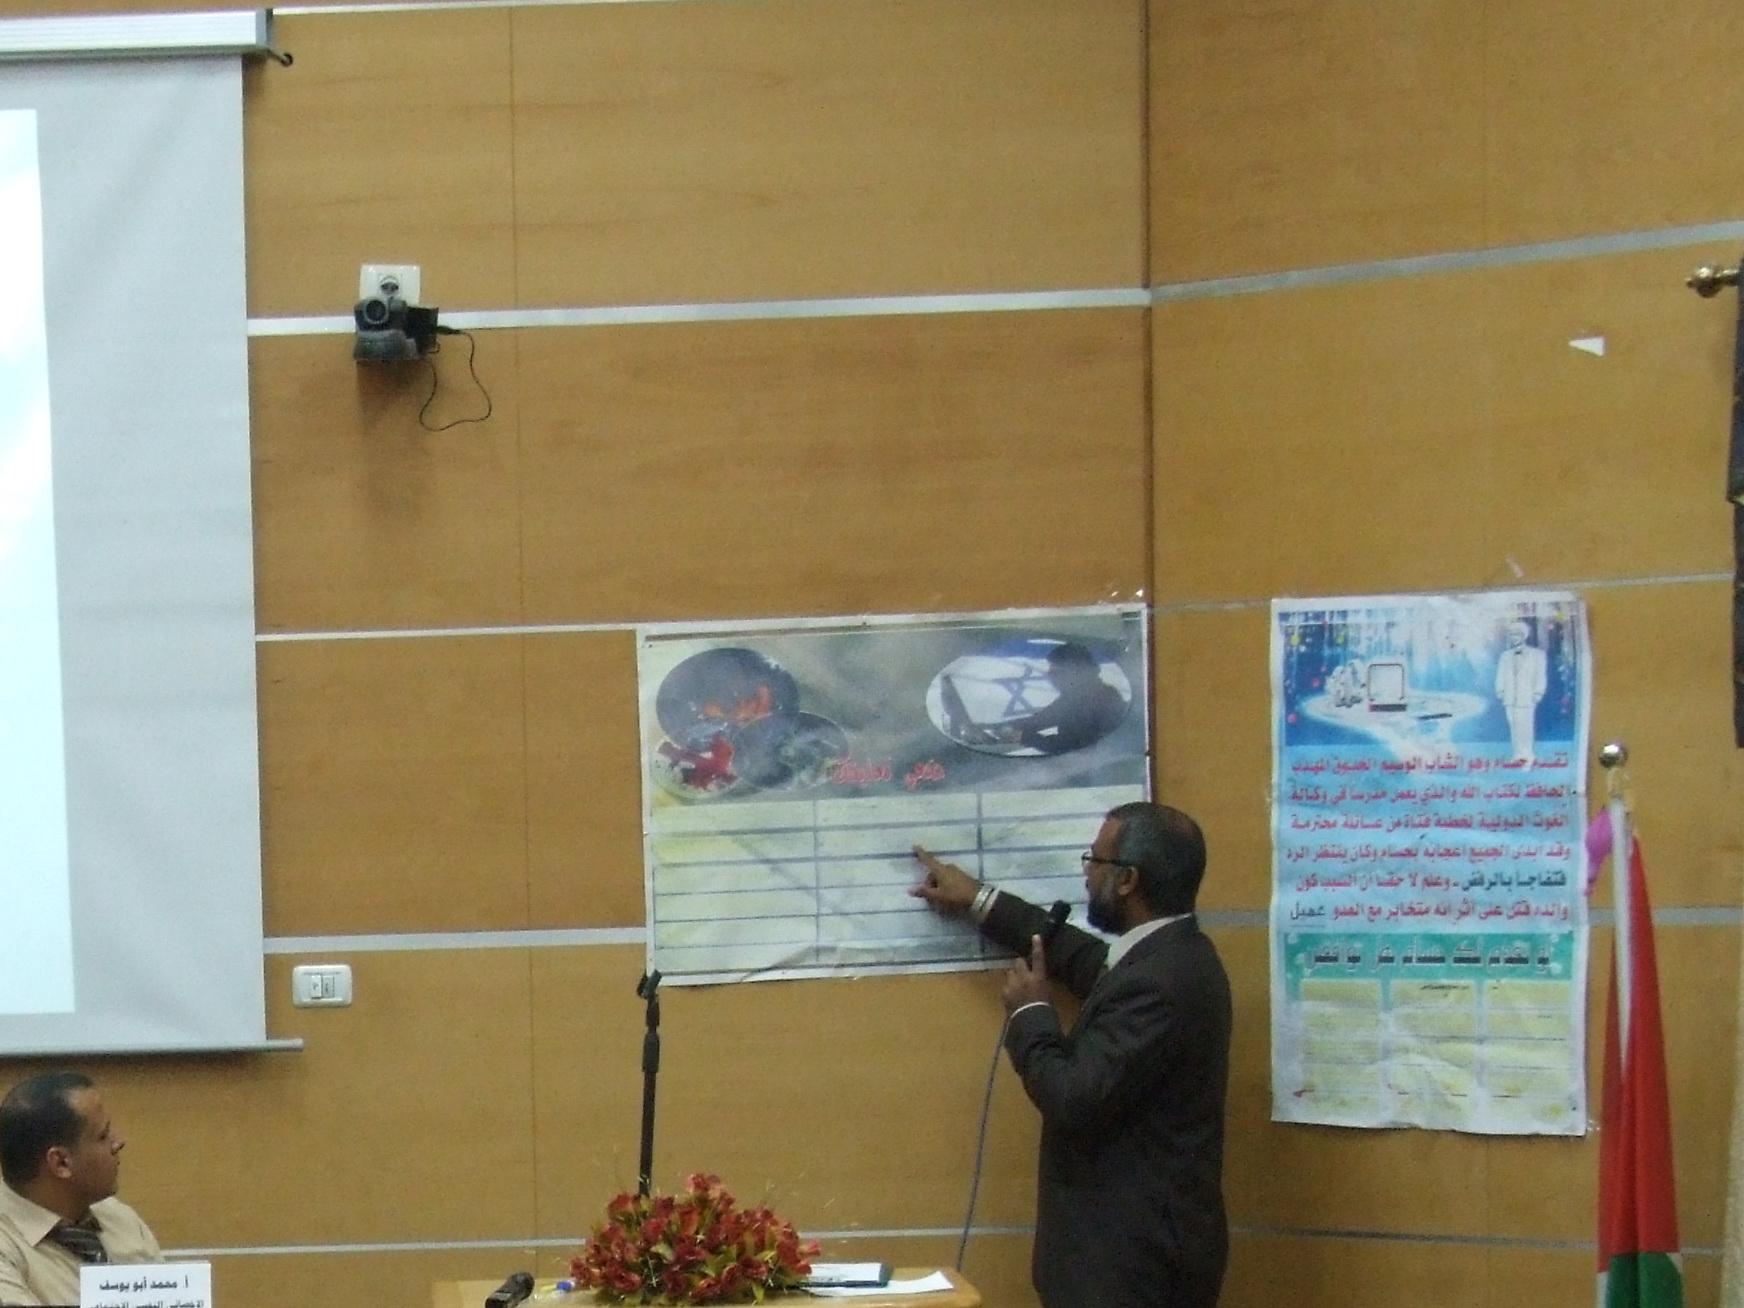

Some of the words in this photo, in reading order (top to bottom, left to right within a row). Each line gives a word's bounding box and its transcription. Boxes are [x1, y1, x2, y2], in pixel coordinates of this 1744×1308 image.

[99, 1280, 130, 1293] يوسف
[133, 1276, 148, 1292] أبو
[150, 1279, 178, 1290] محمد
